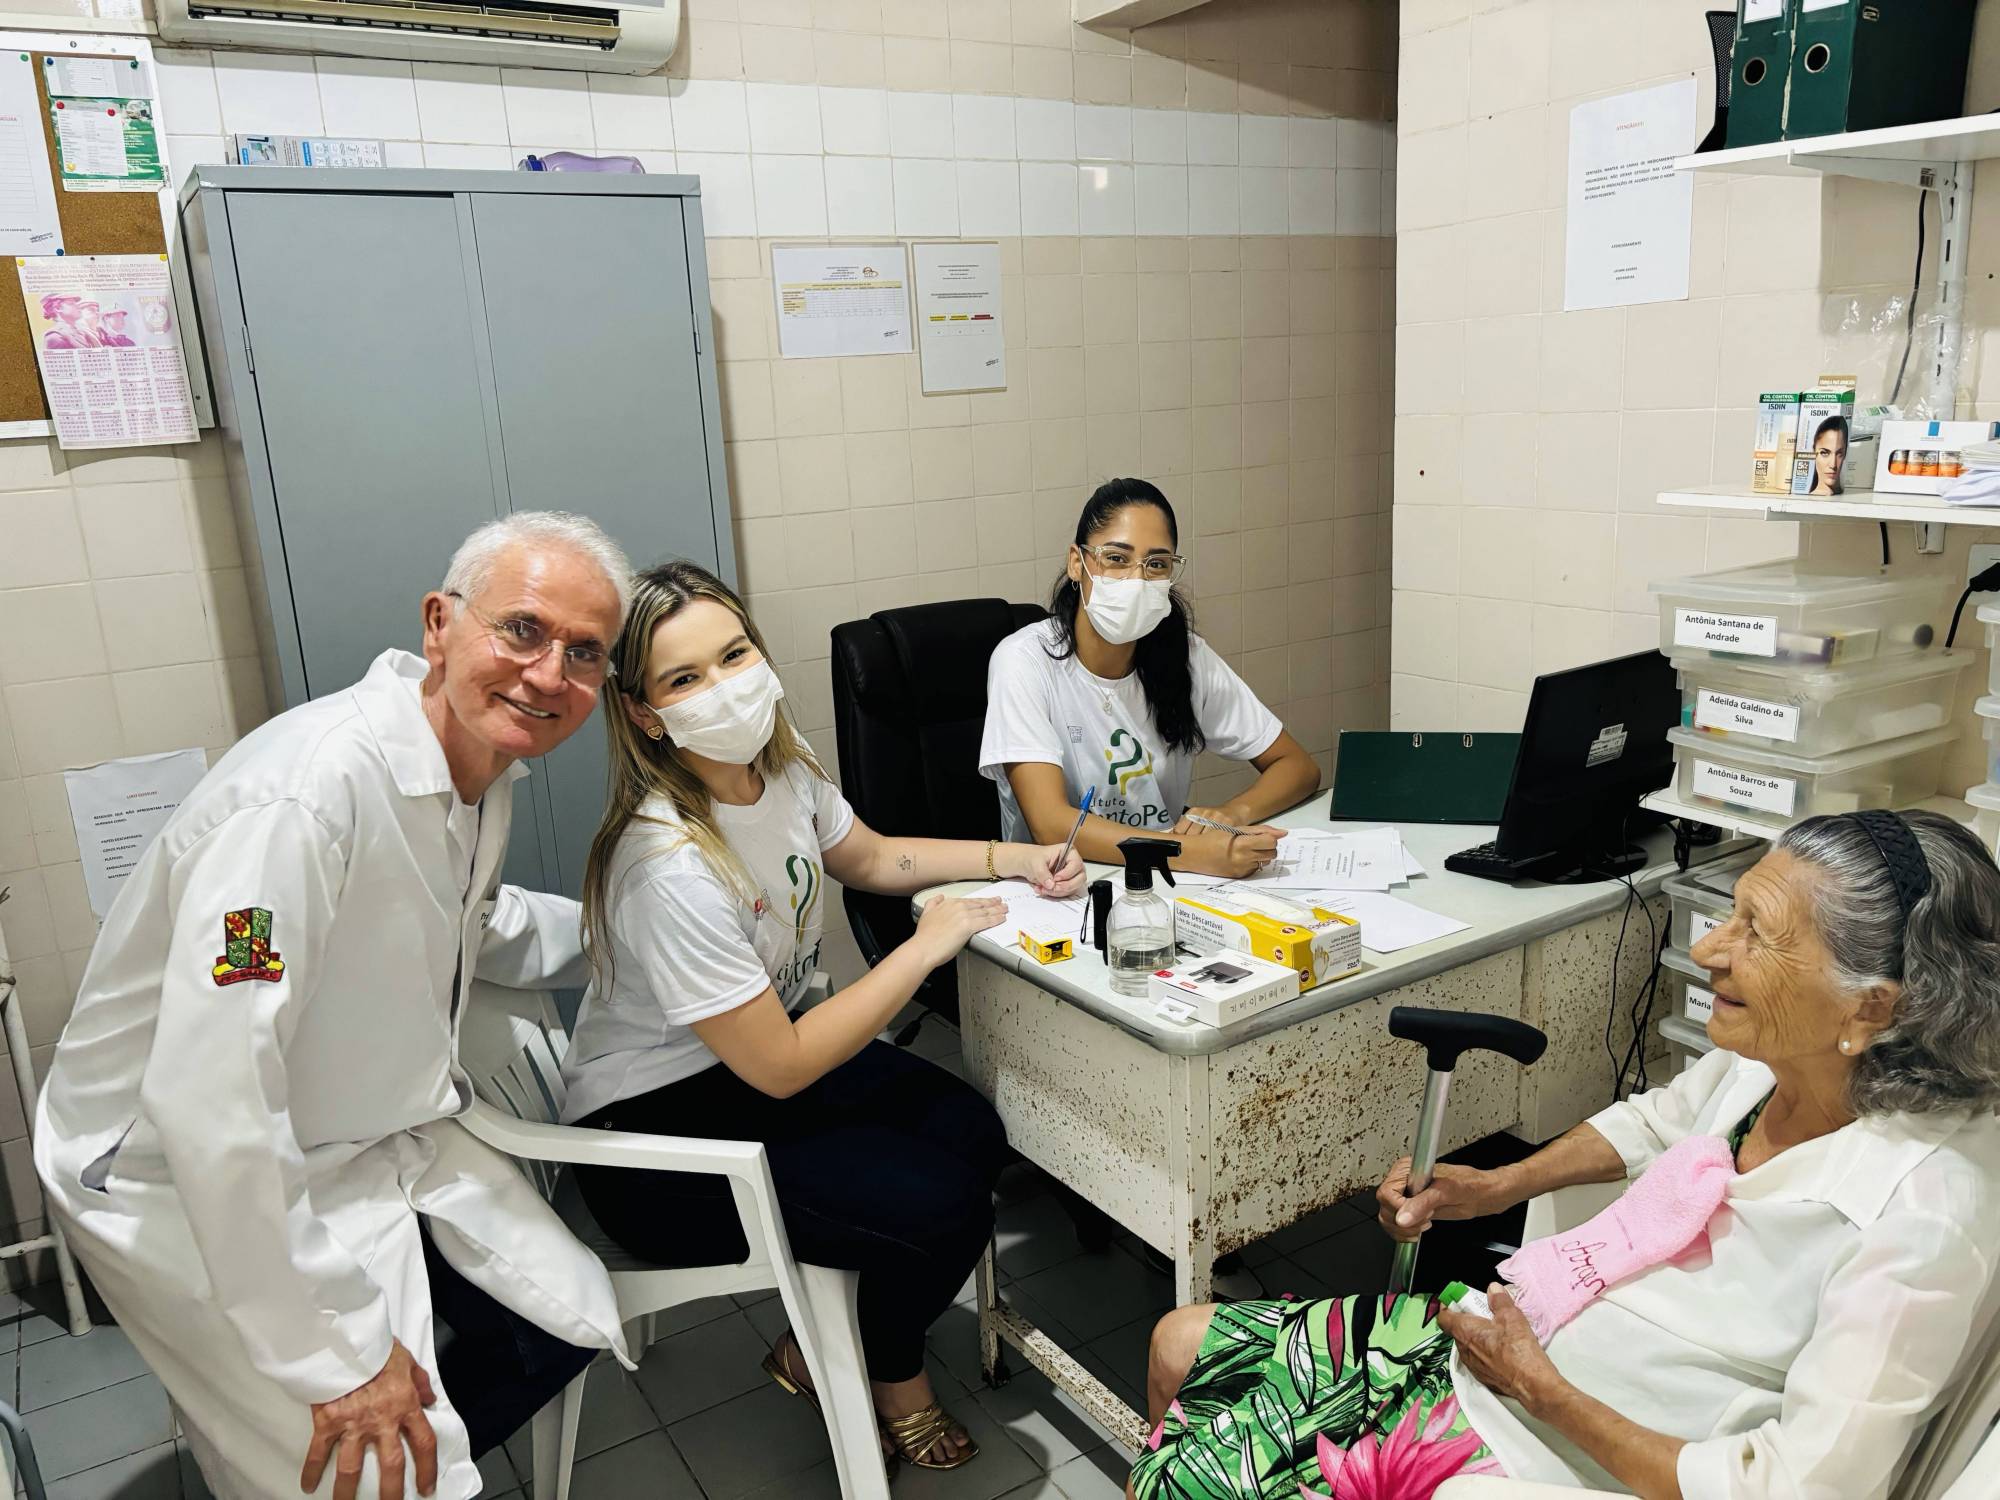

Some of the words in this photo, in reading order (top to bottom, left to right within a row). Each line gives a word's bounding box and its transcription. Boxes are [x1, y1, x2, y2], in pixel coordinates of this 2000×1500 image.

[1685, 615, 1716, 626] Antônia
[1717, 618, 1751, 629] Santana
[1753, 622, 1764, 630] de
[1705, 632, 1740, 643] Andrade
[1709, 695, 1739, 708] Adeilda
[1740, 702, 1771, 715] Galdino
[1773, 708, 1784, 718] da
[1735, 714, 1753, 725] Silva
[1707, 767, 1738, 780] Antônia
[1740, 774, 1766, 787] Barros
[1768, 780, 1779, 789] de
[1729, 786, 1753, 797] Souza
[1689, 996, 1711, 1010] Maria
